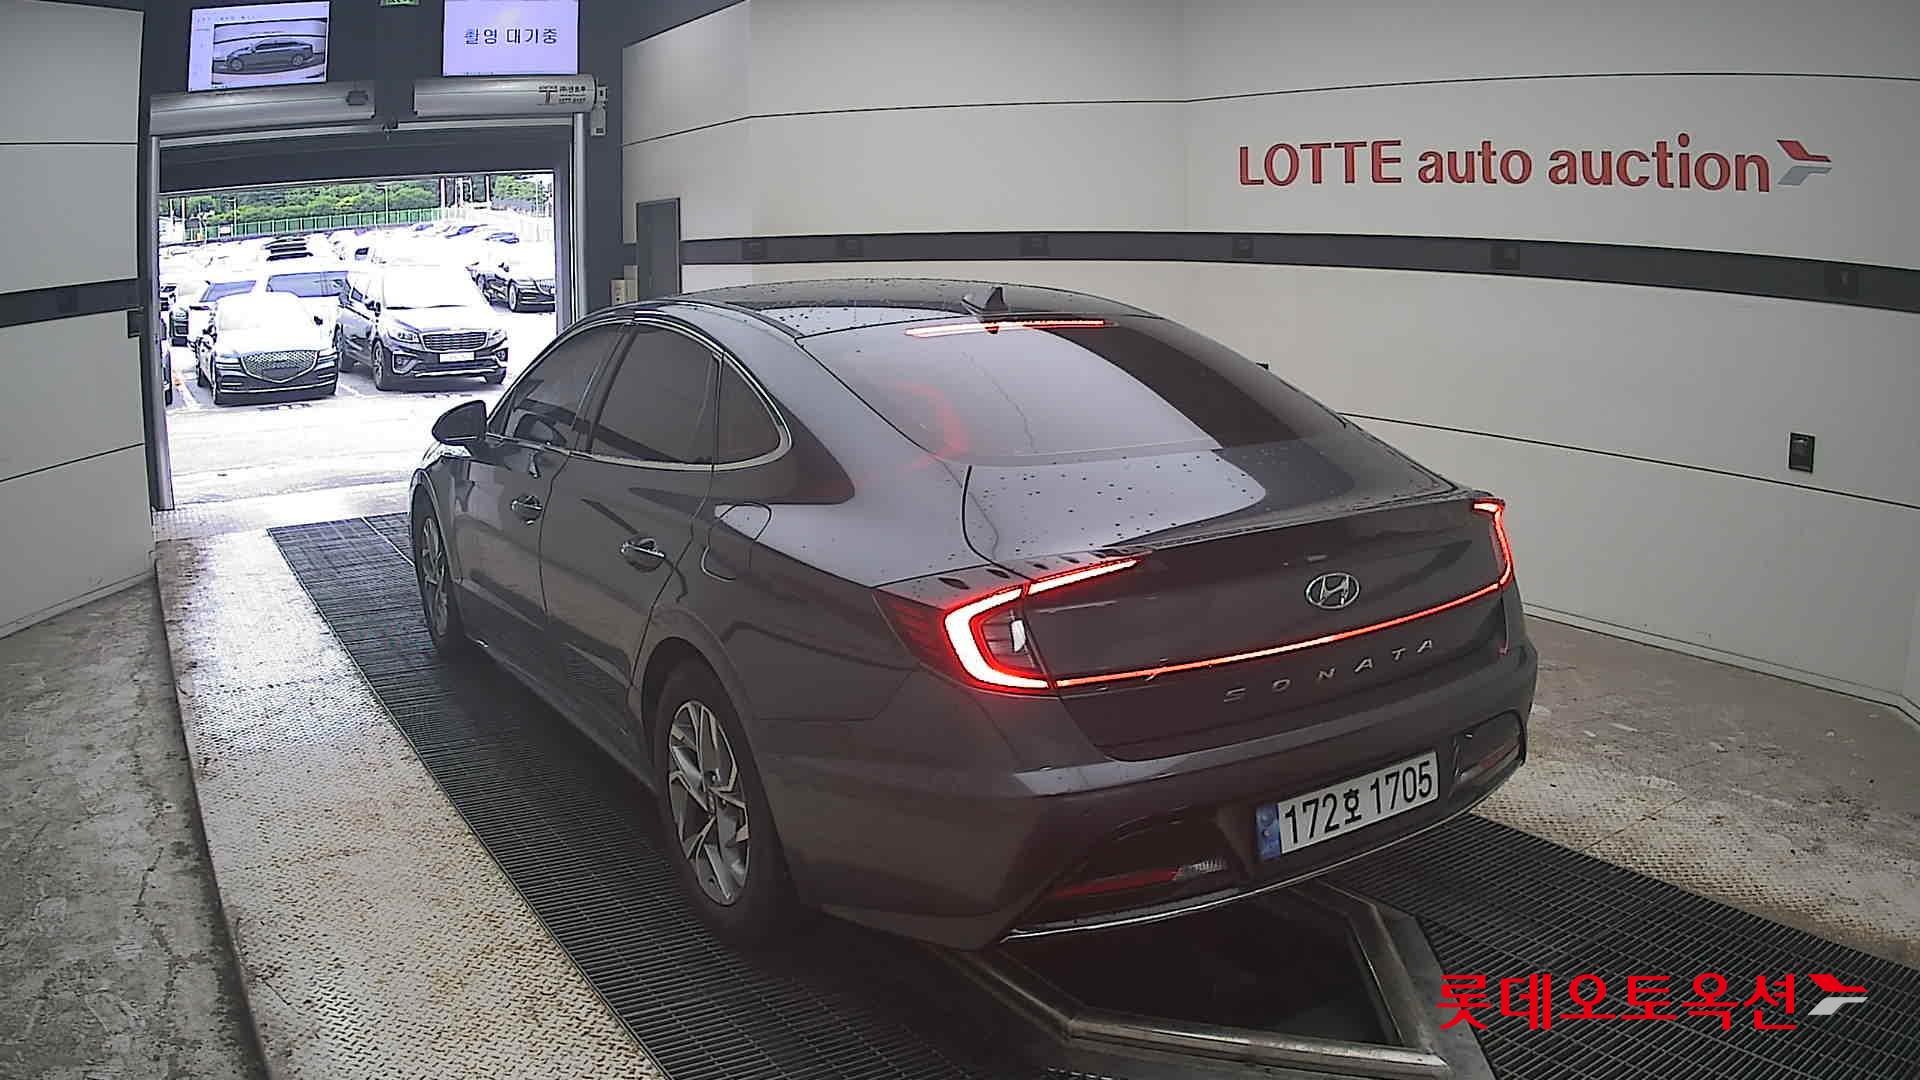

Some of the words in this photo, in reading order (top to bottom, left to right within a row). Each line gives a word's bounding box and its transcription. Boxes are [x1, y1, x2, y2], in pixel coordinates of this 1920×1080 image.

[506, 28, 558, 44] 대기중
[1240, 140, 1402, 186] LOTTE
[1418, 141, 1532, 185] auto
[1548, 134, 1771, 192] auction
[1224, 640, 1433, 702] SONATA
[1284, 788, 1363, 844] 172호
[1370, 760, 1433, 814] 1705
